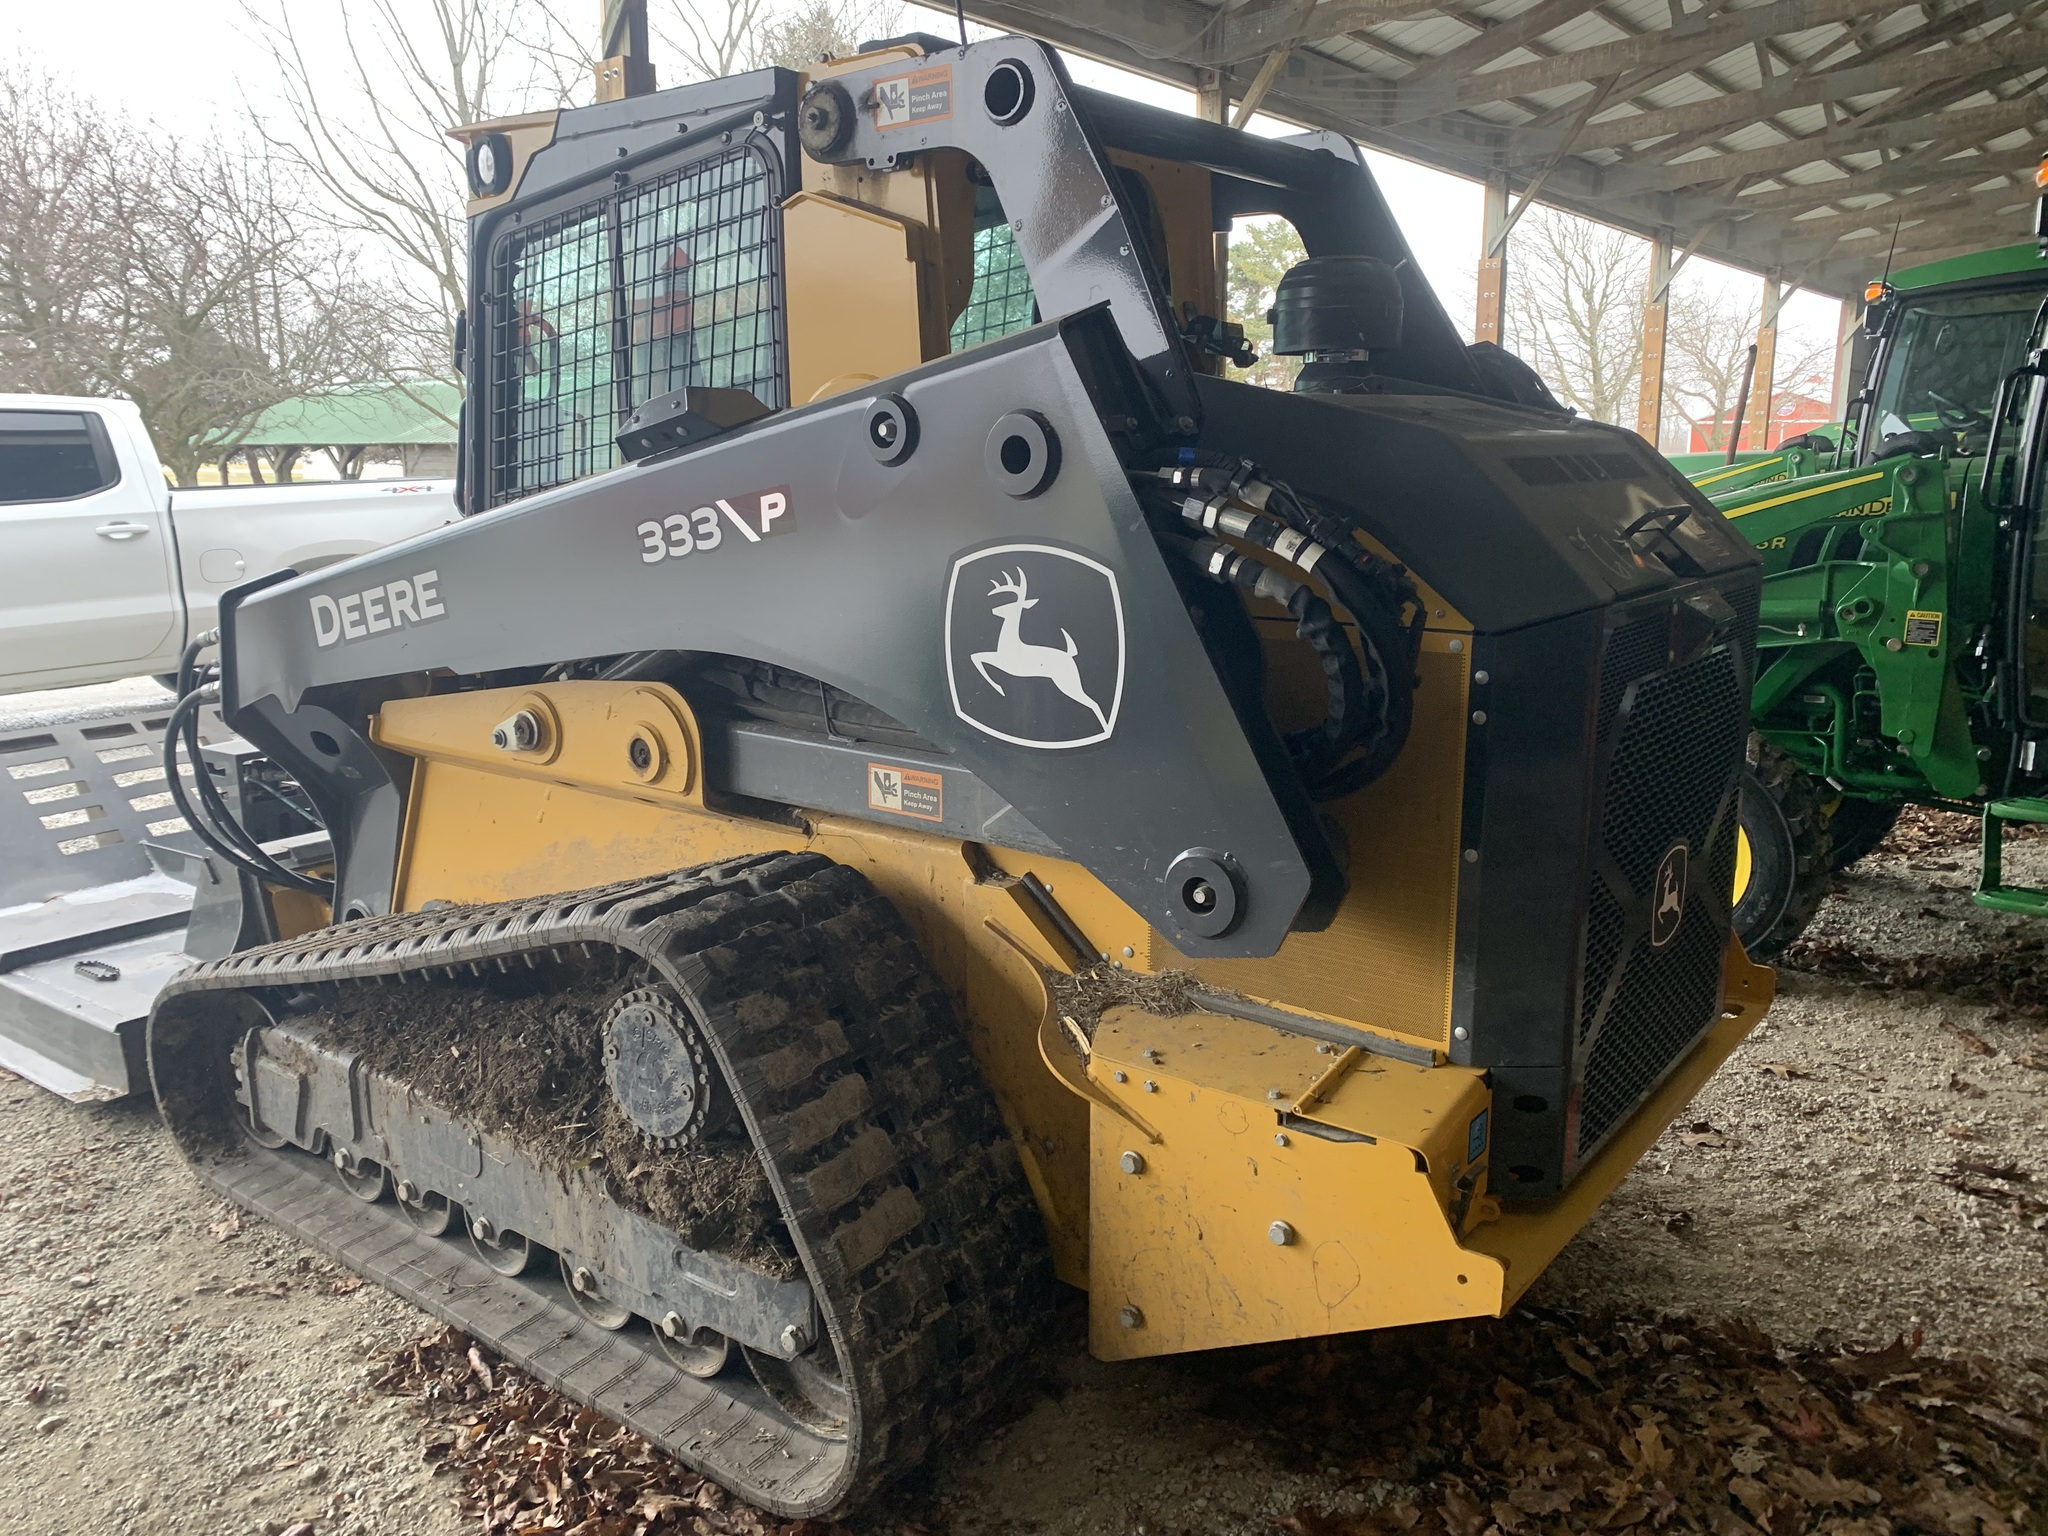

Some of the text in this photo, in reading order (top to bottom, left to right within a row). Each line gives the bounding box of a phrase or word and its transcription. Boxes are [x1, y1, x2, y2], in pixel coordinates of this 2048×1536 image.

[917, 70, 948, 82] WARNING
[911, 90, 947, 103] Pinch Area
[309, 570, 445, 647] DEERE
[910, 775, 938, 785] WARNING
[904, 789, 937, 802] Pinch Area
[904, 799, 932, 811] Keep Away
